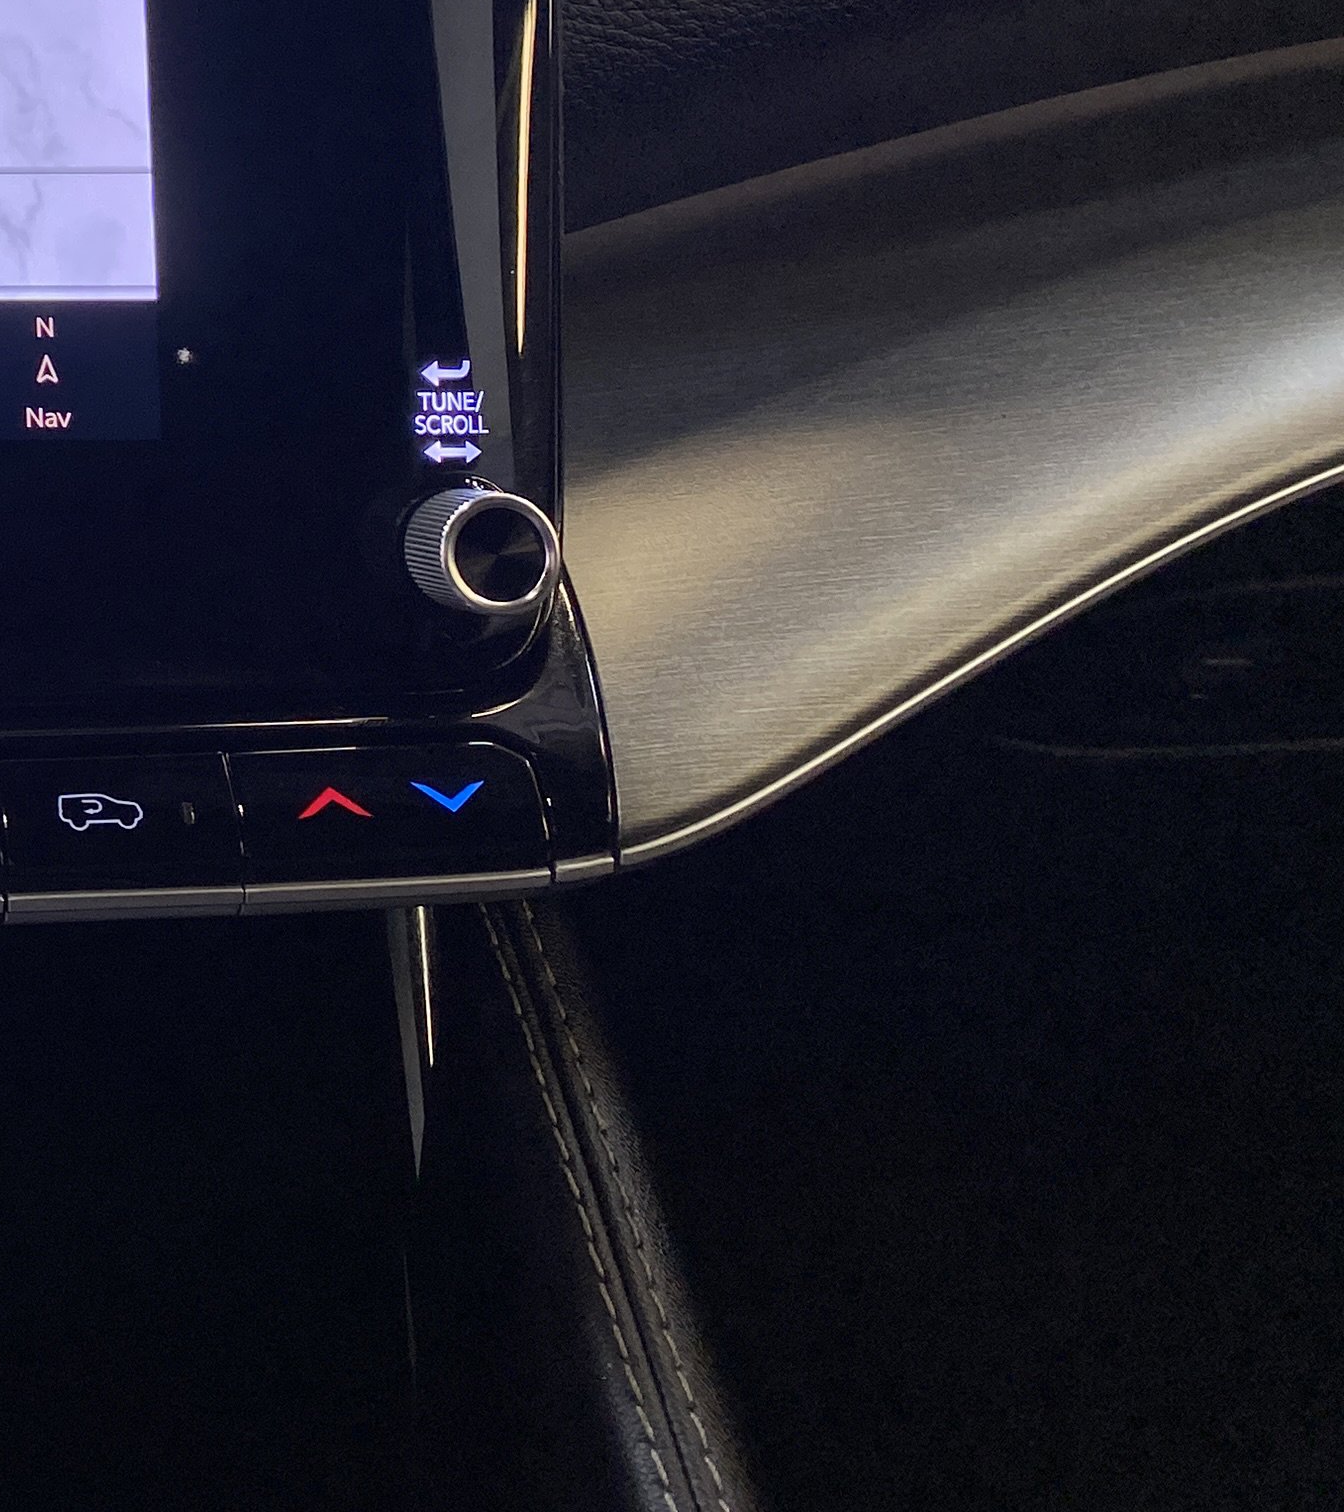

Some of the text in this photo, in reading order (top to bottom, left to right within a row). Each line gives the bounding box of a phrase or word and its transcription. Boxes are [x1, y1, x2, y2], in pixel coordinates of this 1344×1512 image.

[36, 316, 55, 338] N
[416, 390, 485, 412] TUNE/
[25, 406, 72, 428] Nav
[414, 414, 490, 436] SCROLL
